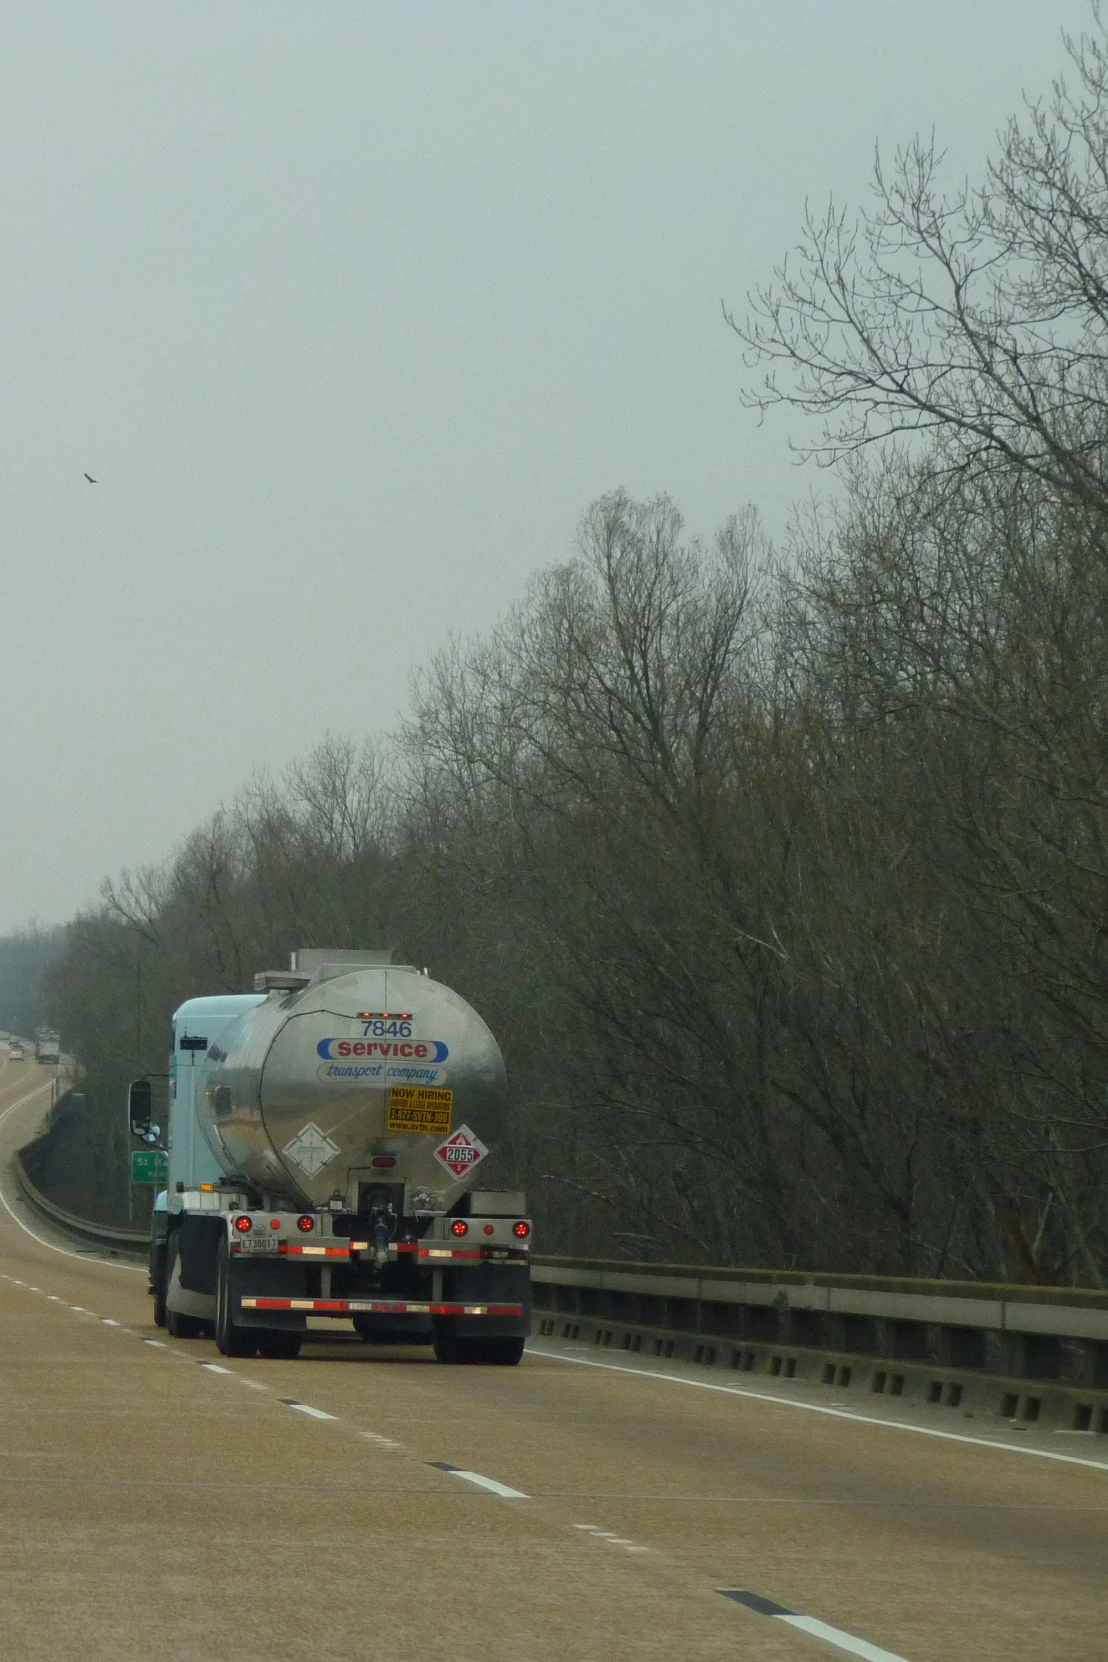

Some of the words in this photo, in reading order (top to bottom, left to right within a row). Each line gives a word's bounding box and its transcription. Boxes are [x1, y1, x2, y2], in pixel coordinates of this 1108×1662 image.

[361, 1020, 412, 1037] 7846
[337, 1041, 429, 1058] service
[327, 1064, 383, 1079] transport
[387, 1067, 439, 1084] company
[392, 1088, 415, 1098] NOW
[418, 1089, 451, 1101] HIRING
[390, 1109, 448, 1123] 1-877-SVTN-JOB
[389, 1122, 448, 1133] www.svtn.com
[448, 1149, 473, 1161] 2055
